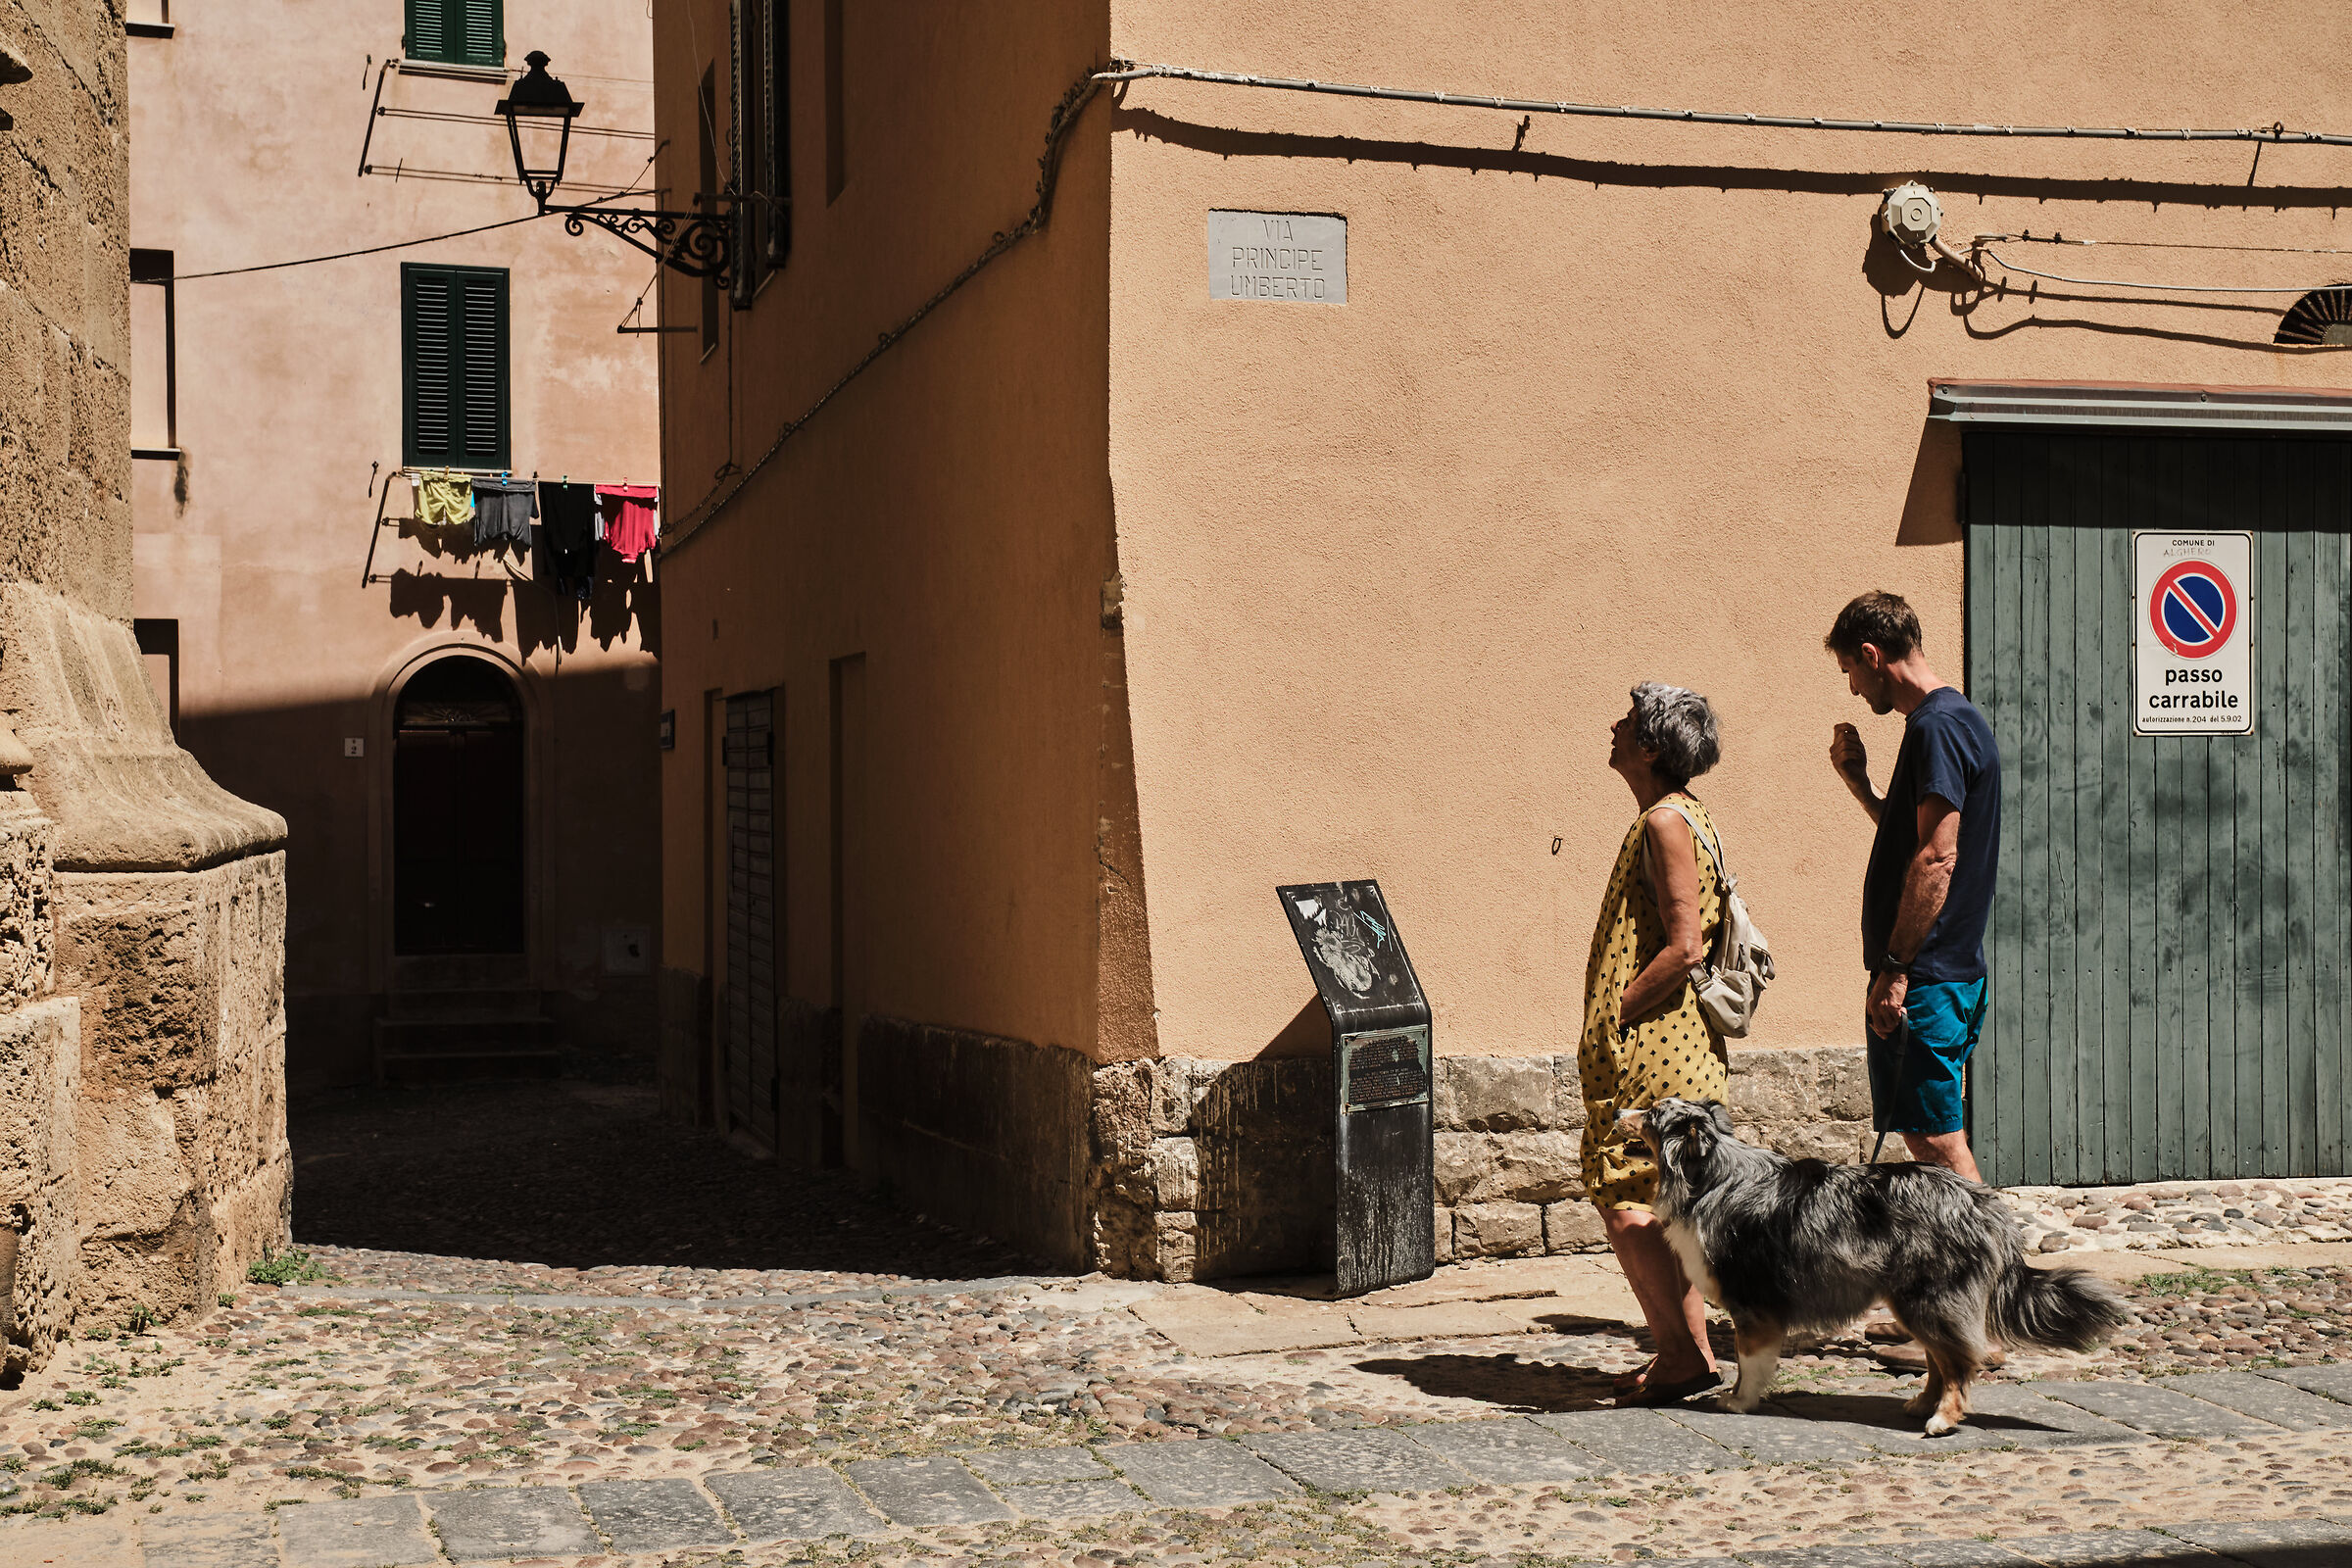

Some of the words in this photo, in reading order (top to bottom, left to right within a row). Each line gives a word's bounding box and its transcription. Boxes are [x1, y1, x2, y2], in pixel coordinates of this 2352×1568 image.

[1262, 220, 1294, 242] VIA
[1232, 246, 1323, 270] PRINCIPE
[1230, 275, 1325, 299] UMBERTO
[2163, 548, 2212, 558] ALGHERO
[2165, 668, 2223, 686] passo
[2148, 690, 2238, 709] carrabile
